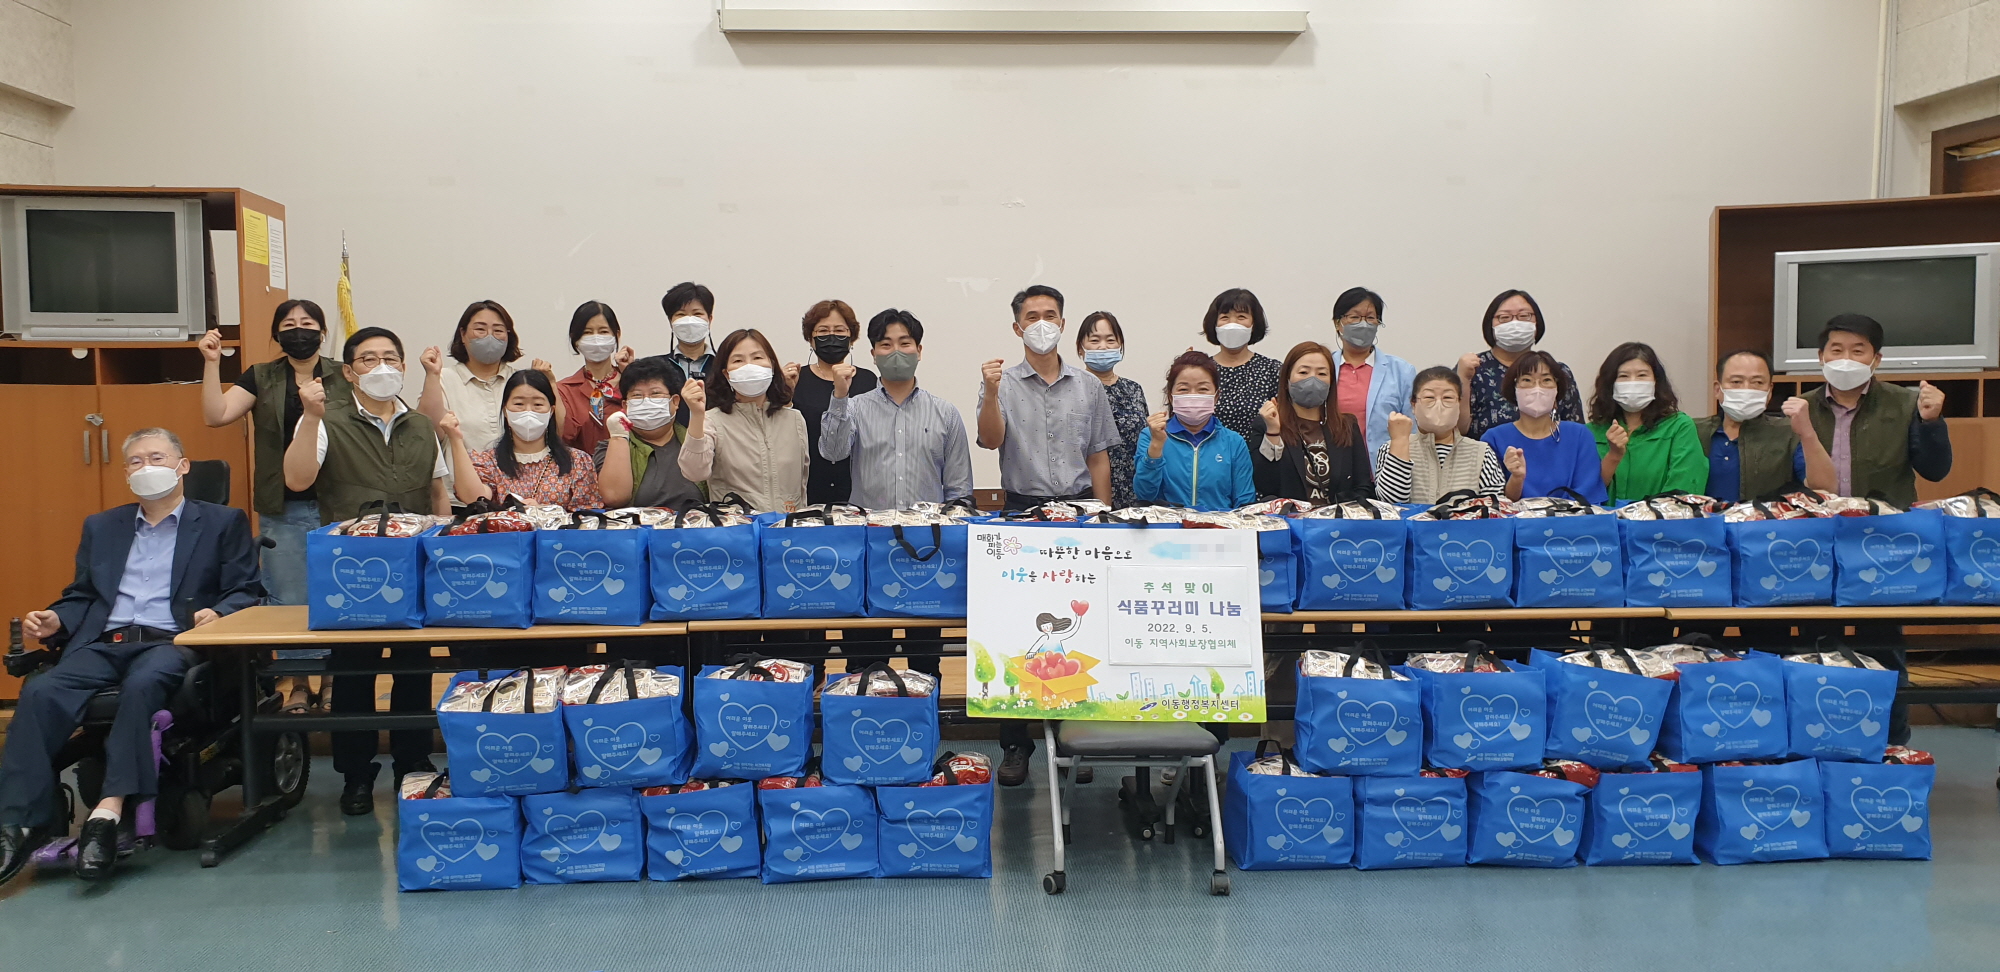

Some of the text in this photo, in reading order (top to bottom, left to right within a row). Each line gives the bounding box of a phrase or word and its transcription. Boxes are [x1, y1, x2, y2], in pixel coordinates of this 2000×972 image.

[977, 533, 1001, 542] 매화가
[987, 549, 1005, 560] 이동
[1040, 546, 1132, 560] 따뜻한 마음으로
[1002, 567, 1096, 584] 이웃을 사랑하는
[1117, 600, 1241, 616] 식품꾸러미 나눔
[1148, 623, 1211, 633] 2022. 9. 5.
[1125, 638, 1236, 650] 이동 지역사회보장협의체
[1161, 699, 1240, 711] 이동행정복지센터
